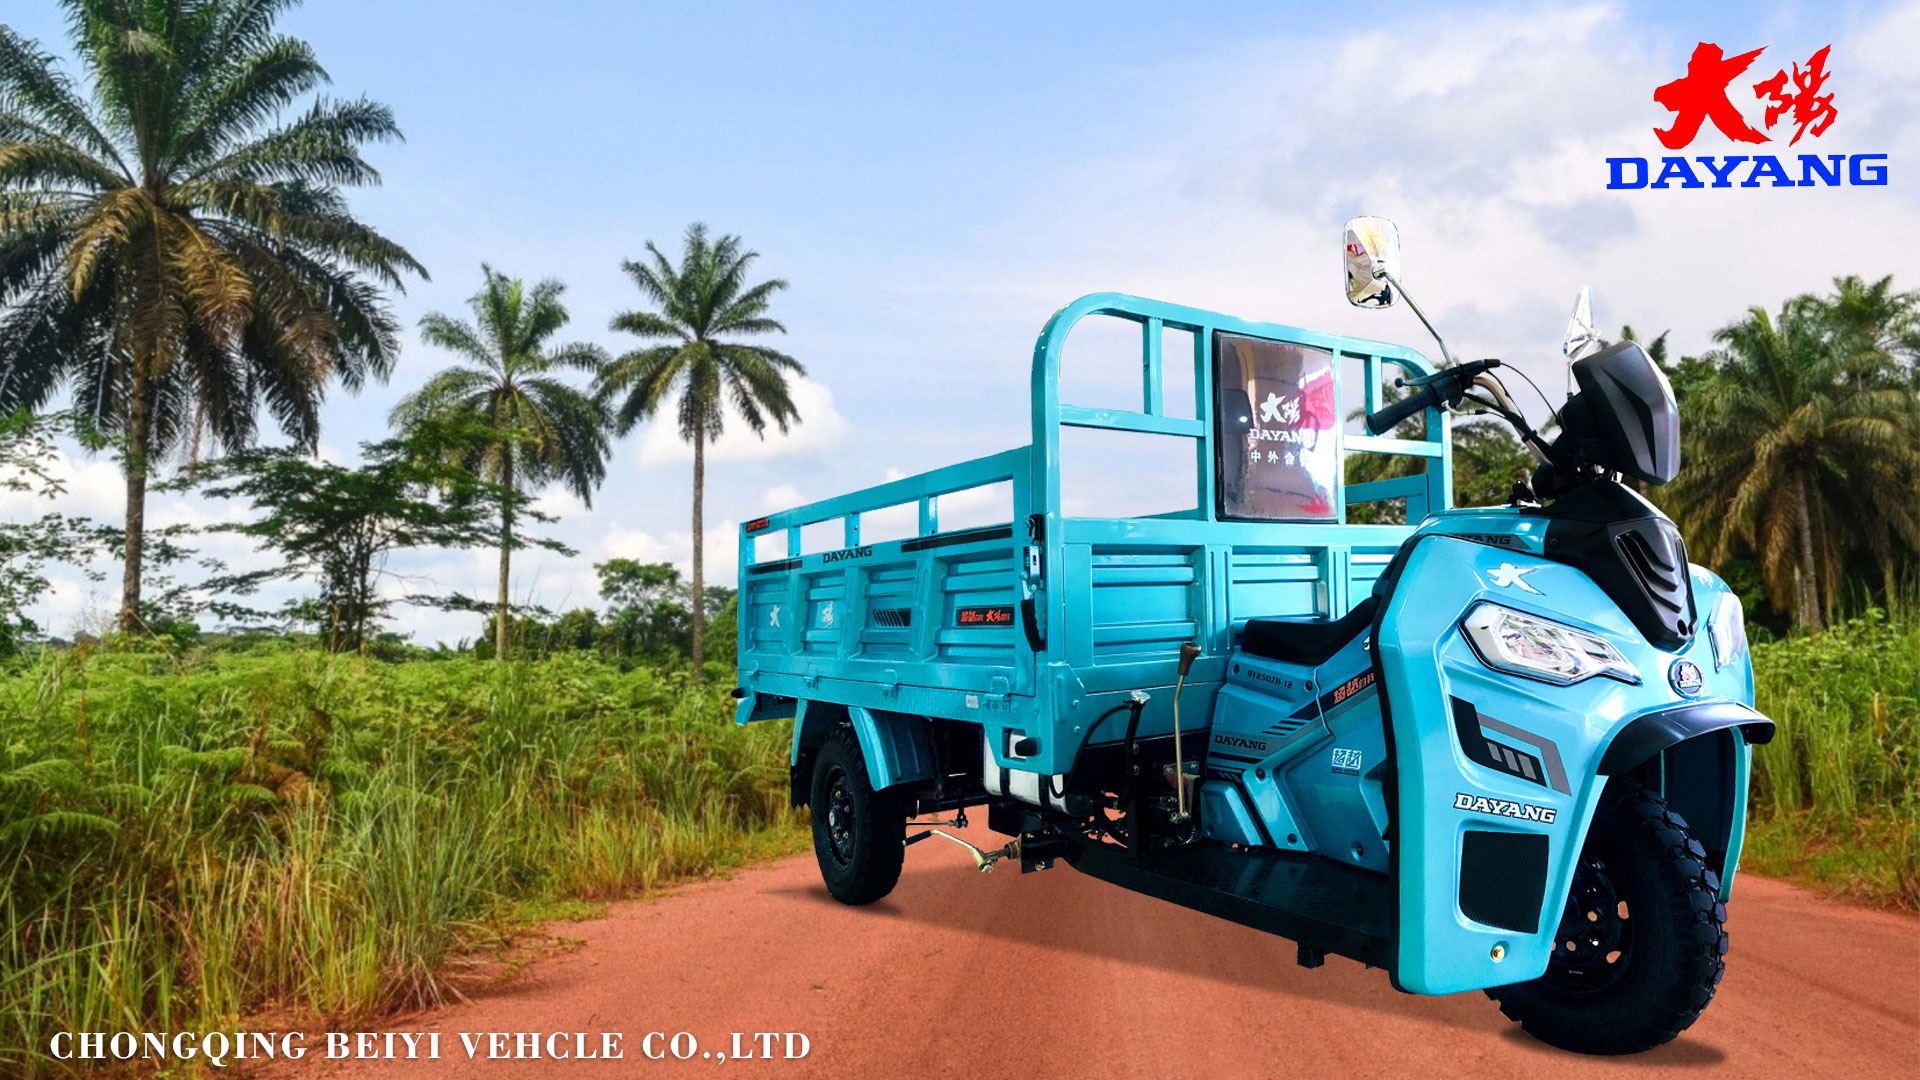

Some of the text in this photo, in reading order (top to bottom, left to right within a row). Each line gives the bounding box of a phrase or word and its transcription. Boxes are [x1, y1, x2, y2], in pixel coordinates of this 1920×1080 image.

[1249, 428, 1314, 446] DAYAN
[1250, 450, 1312, 467] 中外合
[823, 546, 872, 563] DAYANG
[1214, 735, 1267, 751] DAYANG
[1453, 792, 1557, 824] DAYANG
